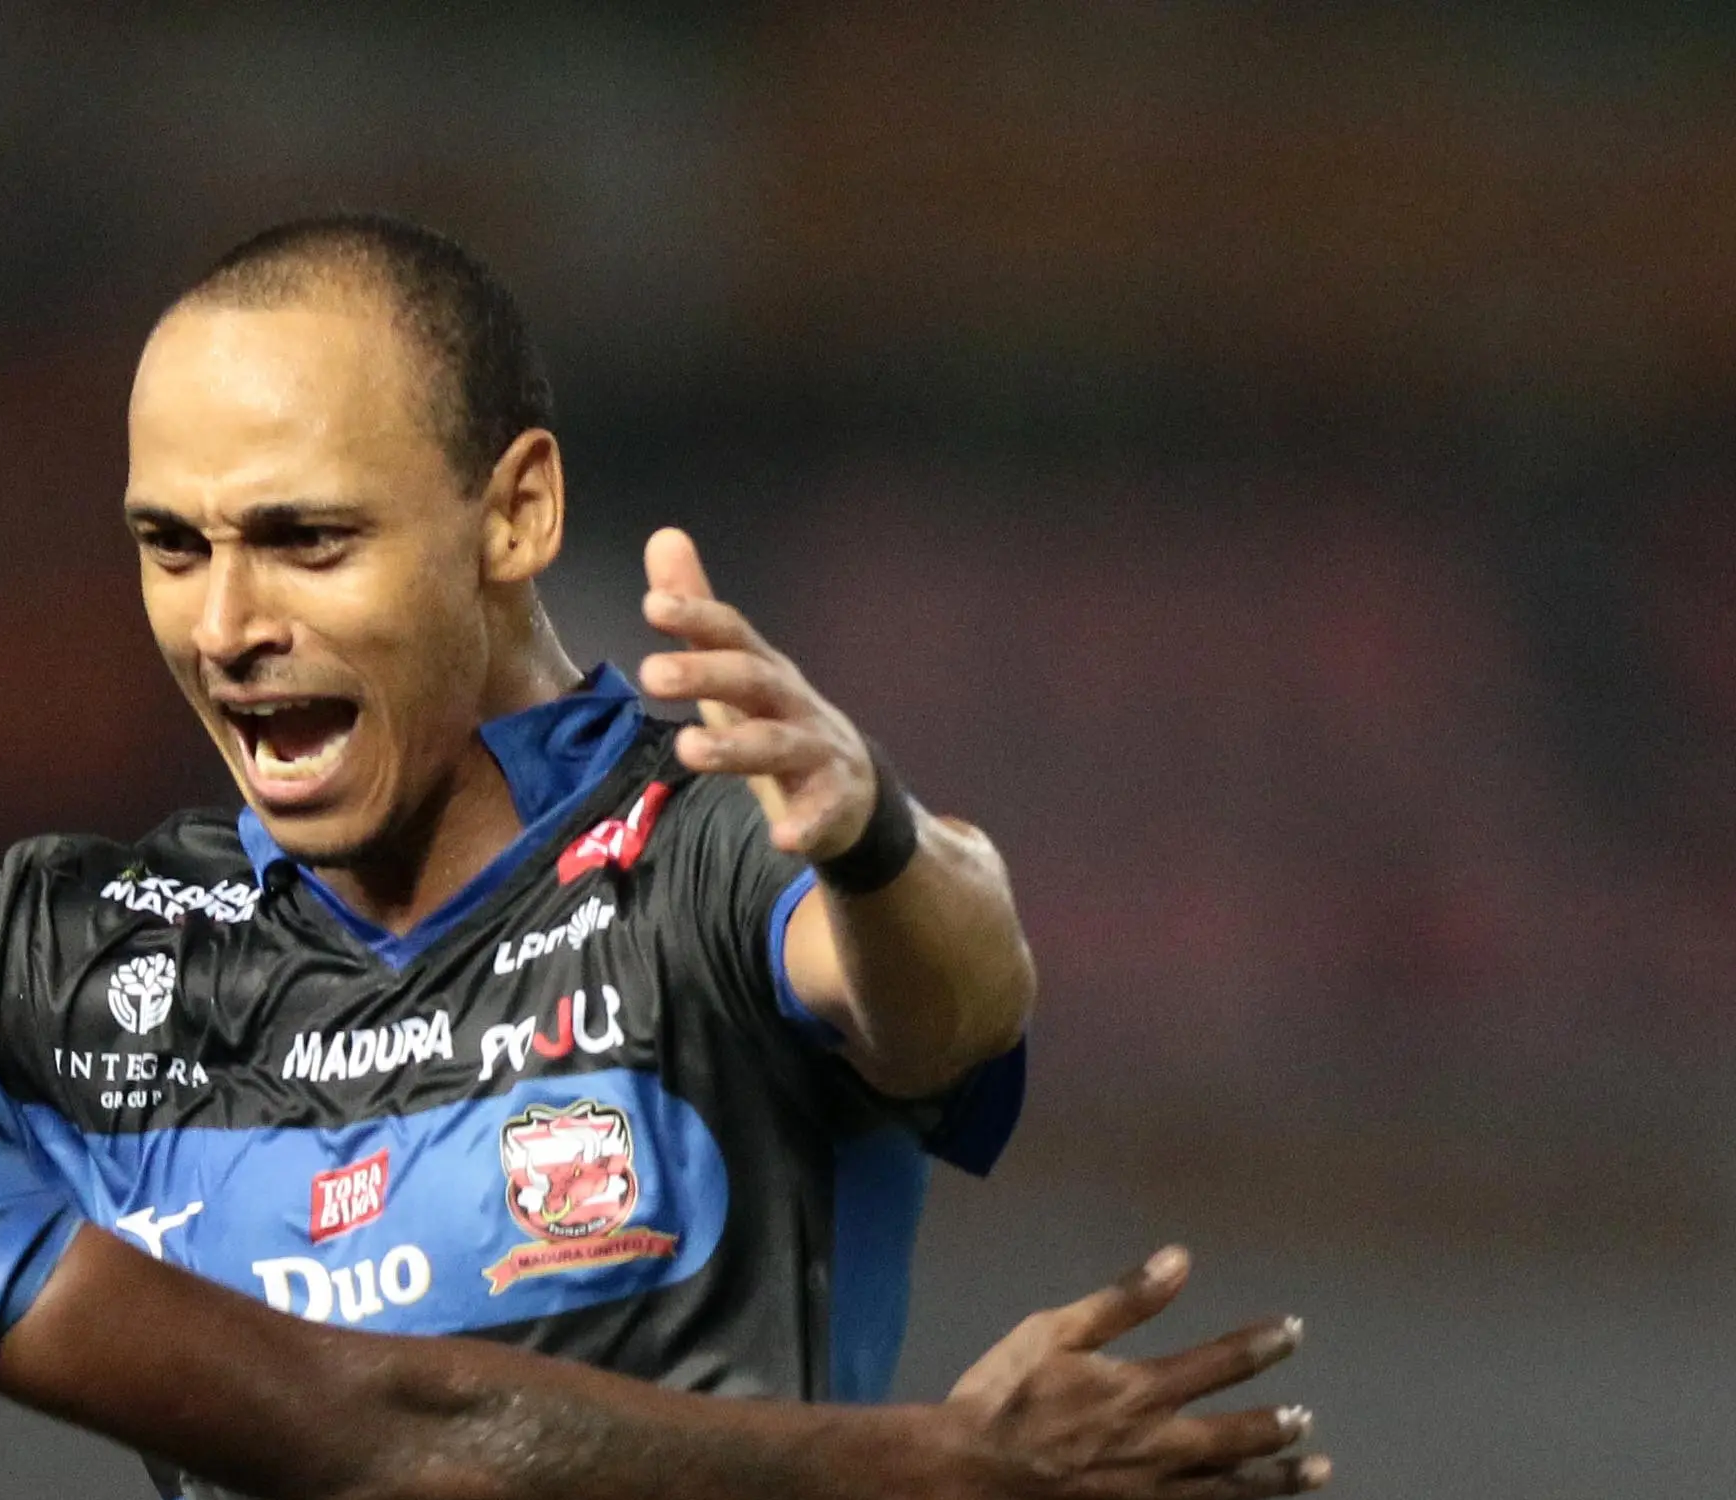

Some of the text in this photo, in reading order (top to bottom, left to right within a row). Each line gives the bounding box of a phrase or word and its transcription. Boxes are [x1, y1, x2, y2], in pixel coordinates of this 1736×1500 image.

[54, 1047, 210, 1089] INTEGRA
[282, 1009, 454, 1082] MADURA
[251, 1243, 432, 1324] Duo
